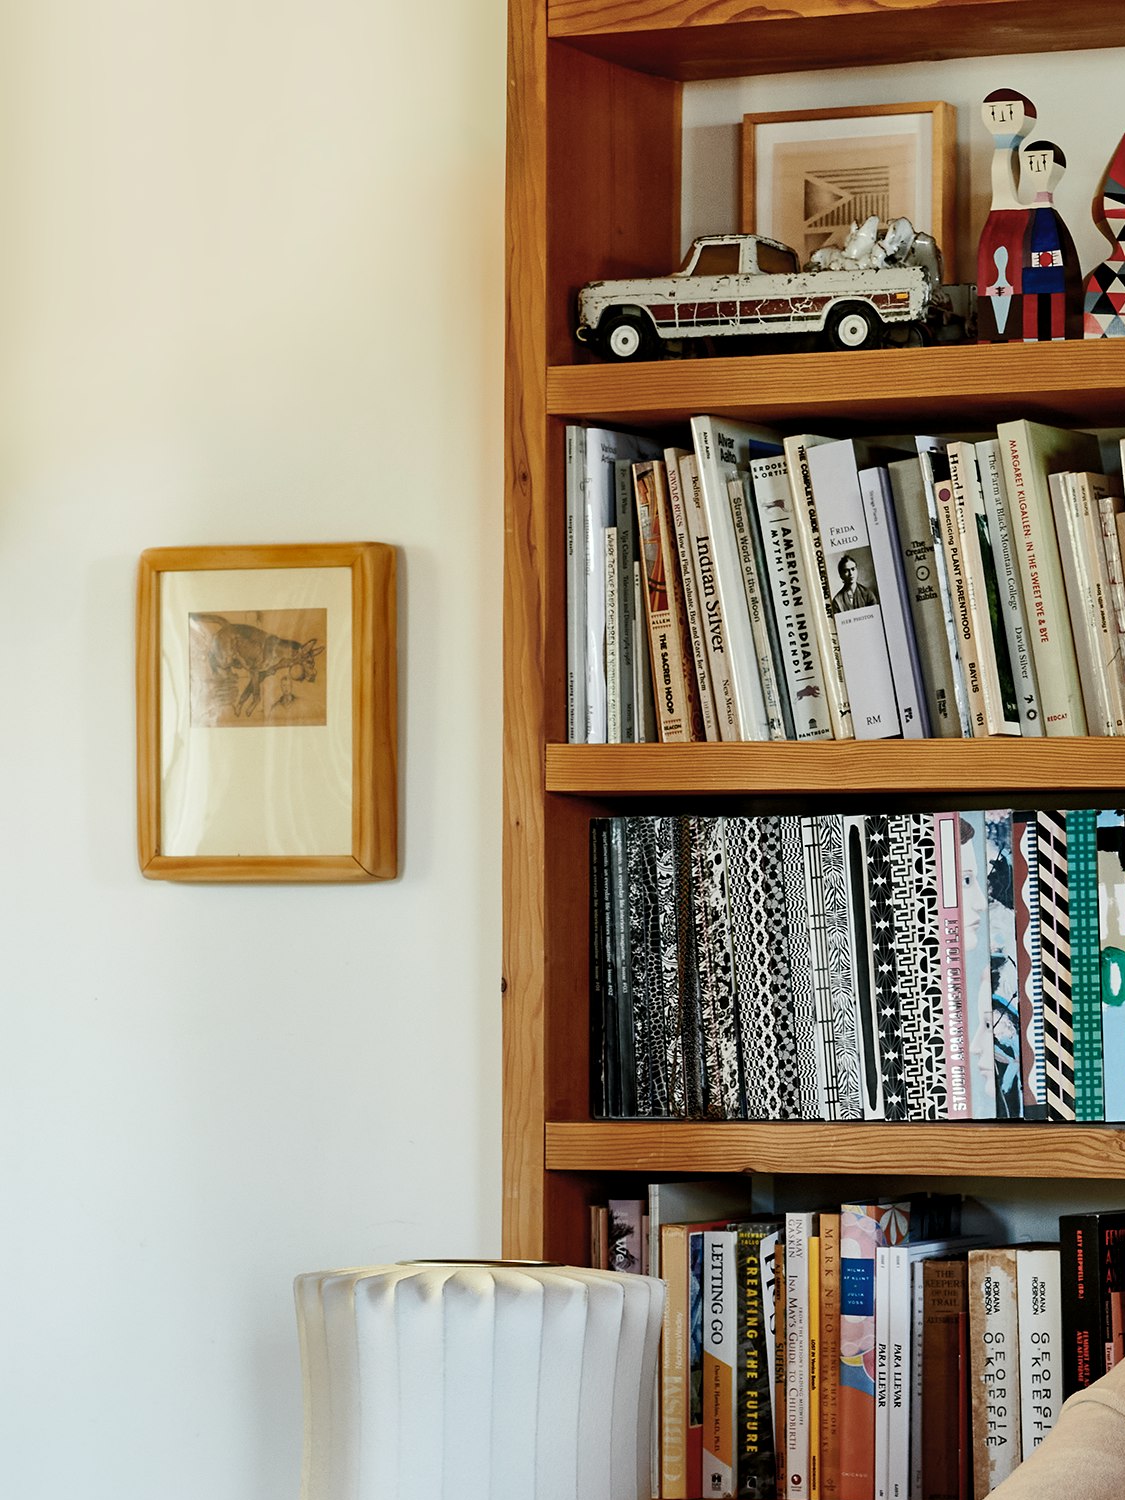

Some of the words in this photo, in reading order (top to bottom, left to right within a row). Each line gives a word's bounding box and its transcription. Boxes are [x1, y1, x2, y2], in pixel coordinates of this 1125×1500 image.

[830, 525, 855, 536] FRIDA
[830, 536, 858, 547] KAHLO
[692, 476, 700, 509] Bedinger
[696, 536, 715, 597] Indian
[706, 600, 724, 653] Silver
[725, 695, 733, 724] Mexico
[771, 530, 784, 572] MYTHS
[778, 580, 790, 606] AND
[786, 615, 801, 674] LEGENDS
[781, 527, 803, 606] AMERICAN
[796, 613, 813, 671] INDIAN
[943, 506, 955, 545] practicing
[951, 547, 961, 577] PLANT
[956, 578, 971, 640] PARENTHOOD
[968, 663, 979, 693] BAYLIS
[976, 712, 984, 726] 101
[866, 715, 881, 726] RM
[945, 919, 959, 944] LET
[946, 946, 960, 964] TO
[946, 966, 965, 1062] APARTAMENTO
[951, 1065, 966, 1112] STUDIO
[824, 1227, 833, 1277] MARK
[711, 1242, 723, 1316] LETTING
[746, 1256, 759, 1339] CREATING
[984, 1276, 993, 1316] ROBINSON
[711, 1320, 723, 1345] GO
[824, 1288, 833, 1334] NEPO
[747, 1349, 759, 1379] THE
[983, 1332, 997, 1447] O'KEEFFE
[993, 1332, 1008, 1447] GEORGIA
[746, 1390, 759, 1454] FUTURE
